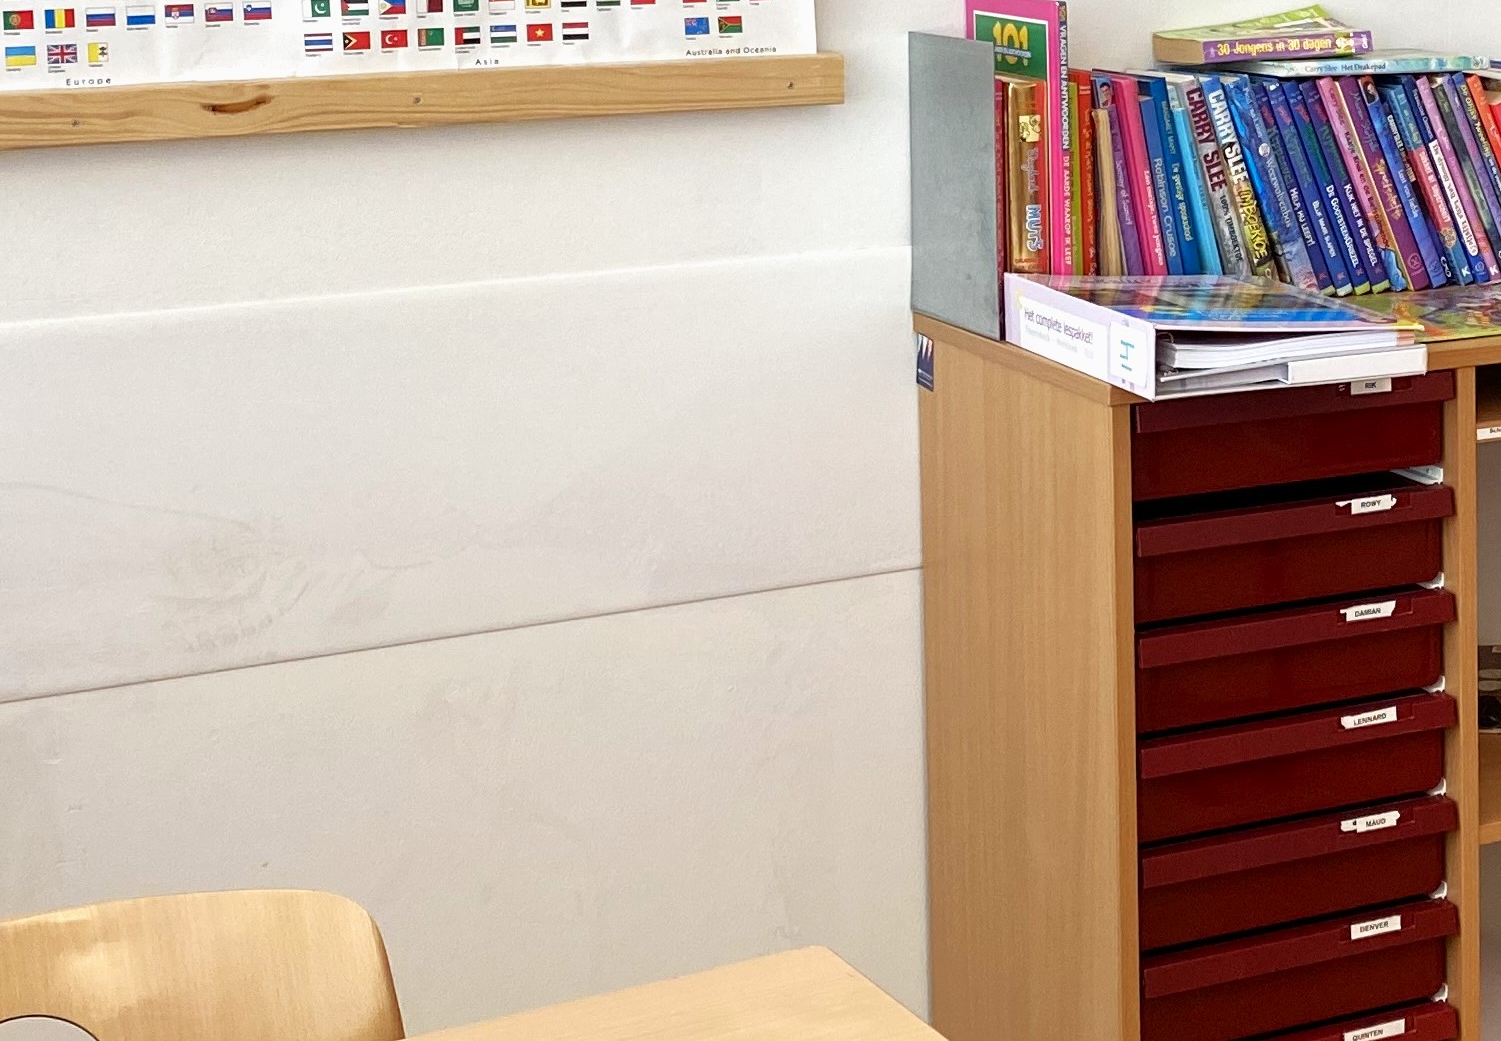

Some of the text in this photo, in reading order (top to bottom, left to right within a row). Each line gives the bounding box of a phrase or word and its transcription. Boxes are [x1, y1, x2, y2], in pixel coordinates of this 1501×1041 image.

[686, 48, 723, 56] Australia
[1060, 25, 1068, 66] VRAGEN
[1216, 43, 1230, 56] 30
[1276, 39, 1284, 52] in
[1288, 38, 1300, 51] 30
[1303, 36, 1332, 51] dagen
[1061, 66, 1069, 78] EN
[66, 78, 112, 86] Europe
[1183, 86, 1216, 146] CARRY
[1201, 150, 1230, 193] SLEE
[1207, 88, 1250, 184] CARRY SLEE
[1063, 156, 1069, 168] DE
[1325, 185, 1336, 198] DE
[1362, 184, 1372, 196] de
[1153, 157, 1179, 258] Robinson Crusoe
[1350, 202, 1362, 218] NIET
[1026, 204, 1043, 252] MUTS
[1356, 218, 1365, 228] IN
[1359, 227, 1369, 239] DE
[1362, 238, 1379, 267] SPIEGEL
[1024, 309, 1034, 322] Het
[1035, 314, 1062, 333] complete
[1354, 713, 1386, 726] LENNARD
[1360, 921, 1389, 932] DENVER
[1353, 1029, 1384, 1041] QUINTEN
